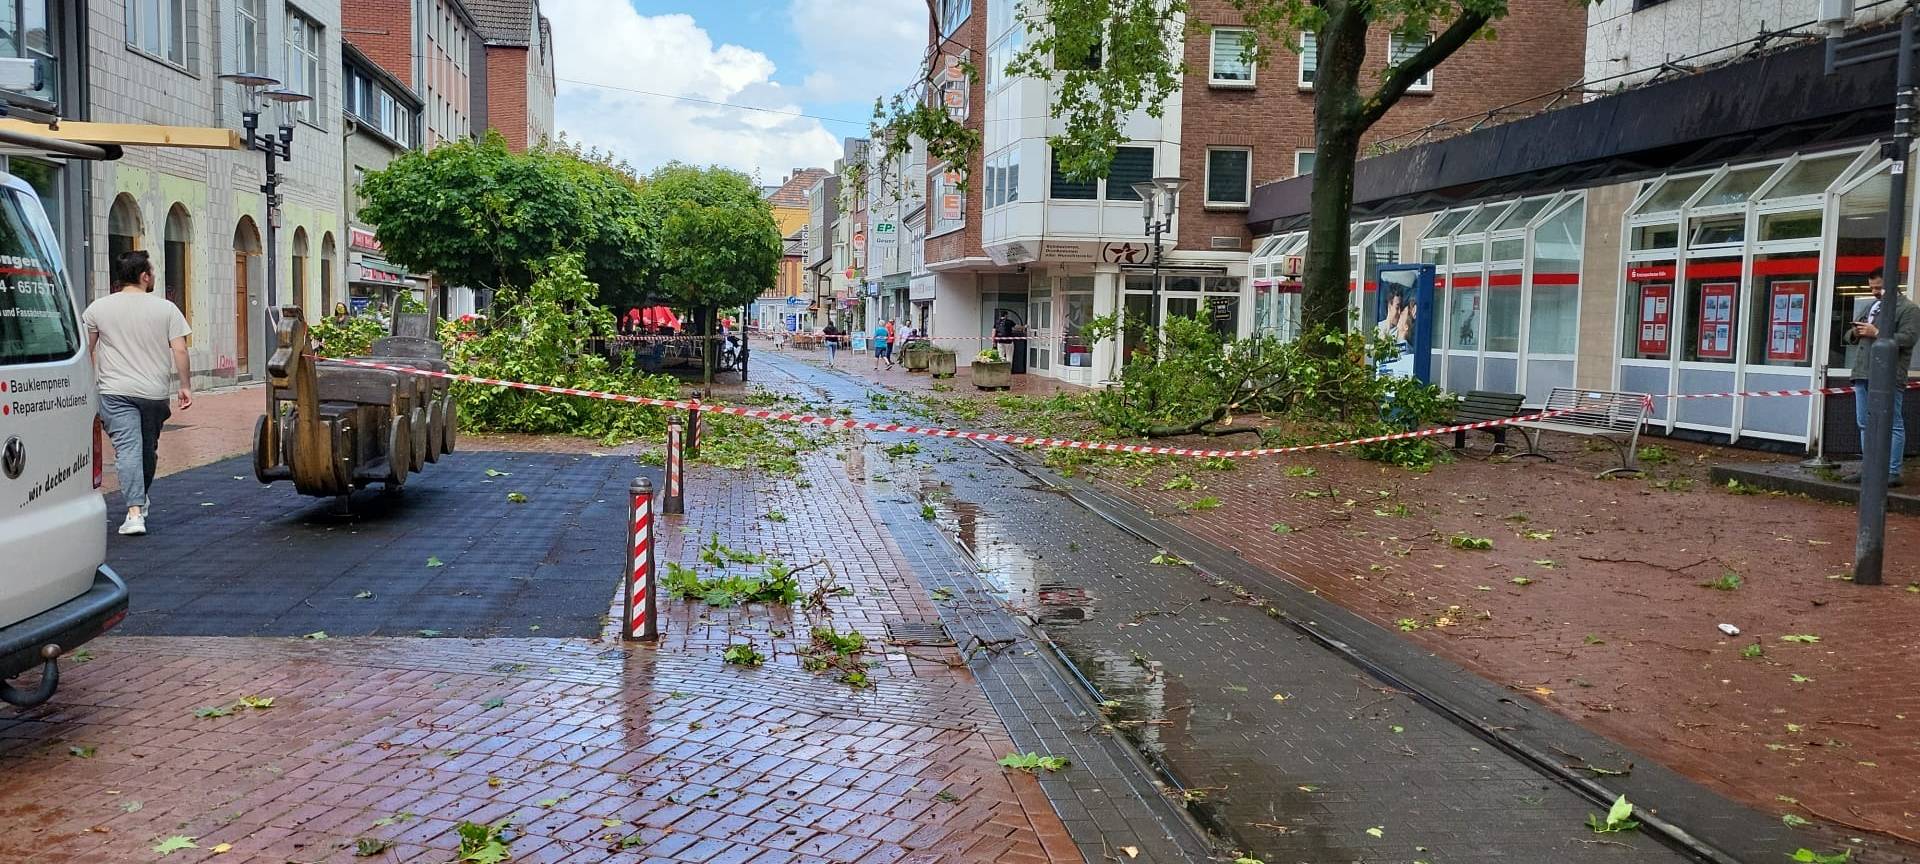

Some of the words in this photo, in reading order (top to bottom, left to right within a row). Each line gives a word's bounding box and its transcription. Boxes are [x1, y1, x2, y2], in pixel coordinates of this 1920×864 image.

[877, 223, 895, 232] EP:
[0, 255, 41, 269] ngen
[10, 376, 71, 394] Bauklempnerei
[12, 394, 88, 416] Reparatur-Notdienst
[44, 468, 71, 492] decken
